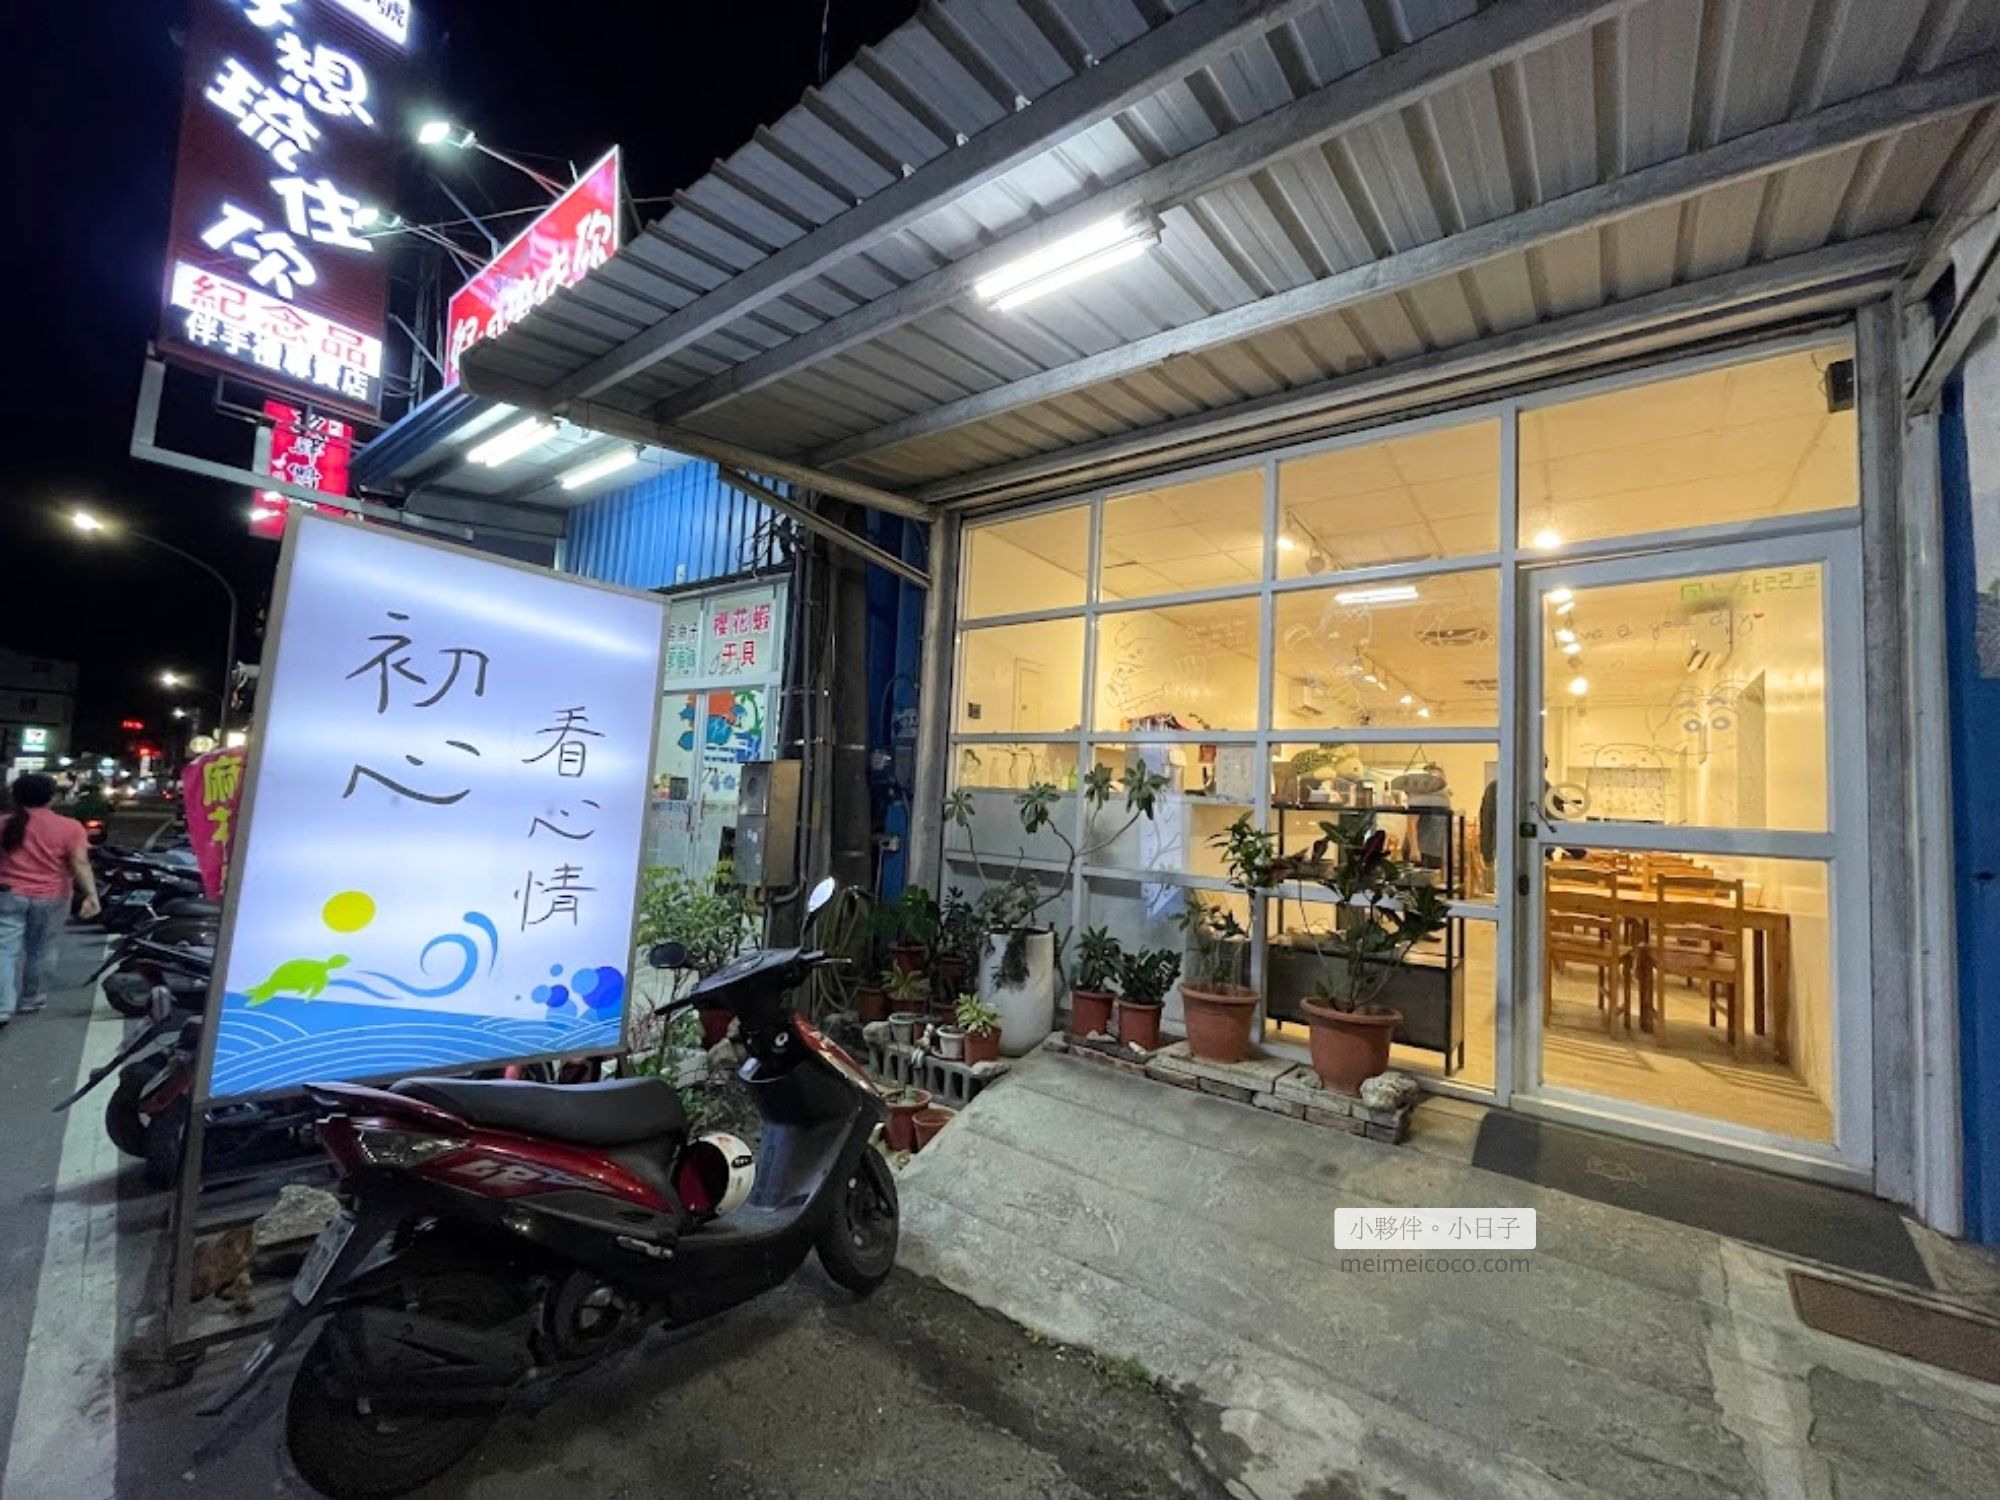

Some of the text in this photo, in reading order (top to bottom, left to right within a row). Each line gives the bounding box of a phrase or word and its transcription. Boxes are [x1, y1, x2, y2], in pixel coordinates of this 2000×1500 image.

[190, 275, 367, 368] 紀念品
[713, 604, 771, 637] 櫻花蝦
[722, 640, 755, 667] 干貝
[342, 611, 490, 805] 初心
[513, 705, 606, 932] 看心情
